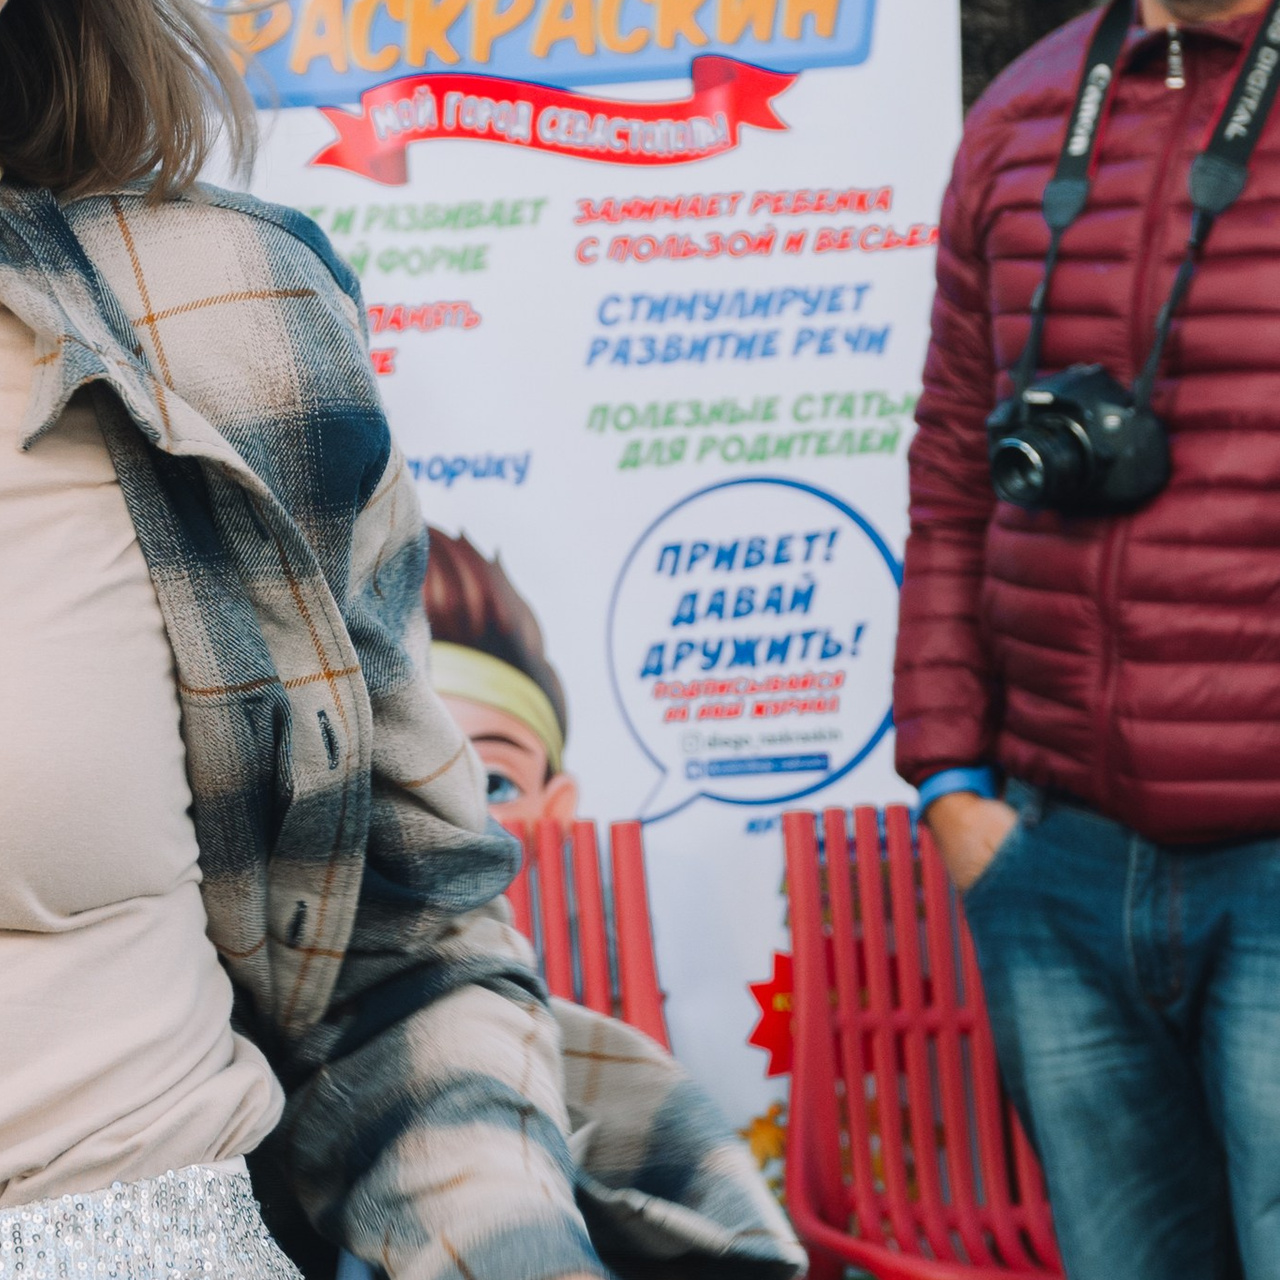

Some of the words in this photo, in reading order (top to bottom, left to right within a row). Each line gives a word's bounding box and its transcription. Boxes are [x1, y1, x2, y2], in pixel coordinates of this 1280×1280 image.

[370, 85, 436, 141] МОЙ
[443, 92, 532, 143] ГОРОД
[1223, 45, 1279, 141] DIGITAL
[574, 192, 743, 225] ЗАНИМАЕТ
[575, 236, 599, 266] С
[607, 223, 777, 263] ПОЛЬЗОЙ
[784, 229, 807, 255] И
[598, 283, 872, 327] СТИМУЛИРУЕТ
[586, 328, 781, 367] РАЗВИТИЕ
[792, 324, 891, 356] РЕЧИ
[586, 396, 782, 433] ПОЛЕЗНЫЕ
[618, 436, 688, 471] ДЛЯ
[696, 421, 902, 464] РОДИТЕЛЕЙ
[656, 528, 840, 577] ПРИВЕТ!
[671, 573, 816, 627] ДАВАЙ
[640, 622, 867, 678] ДРУЖИТЬ!
